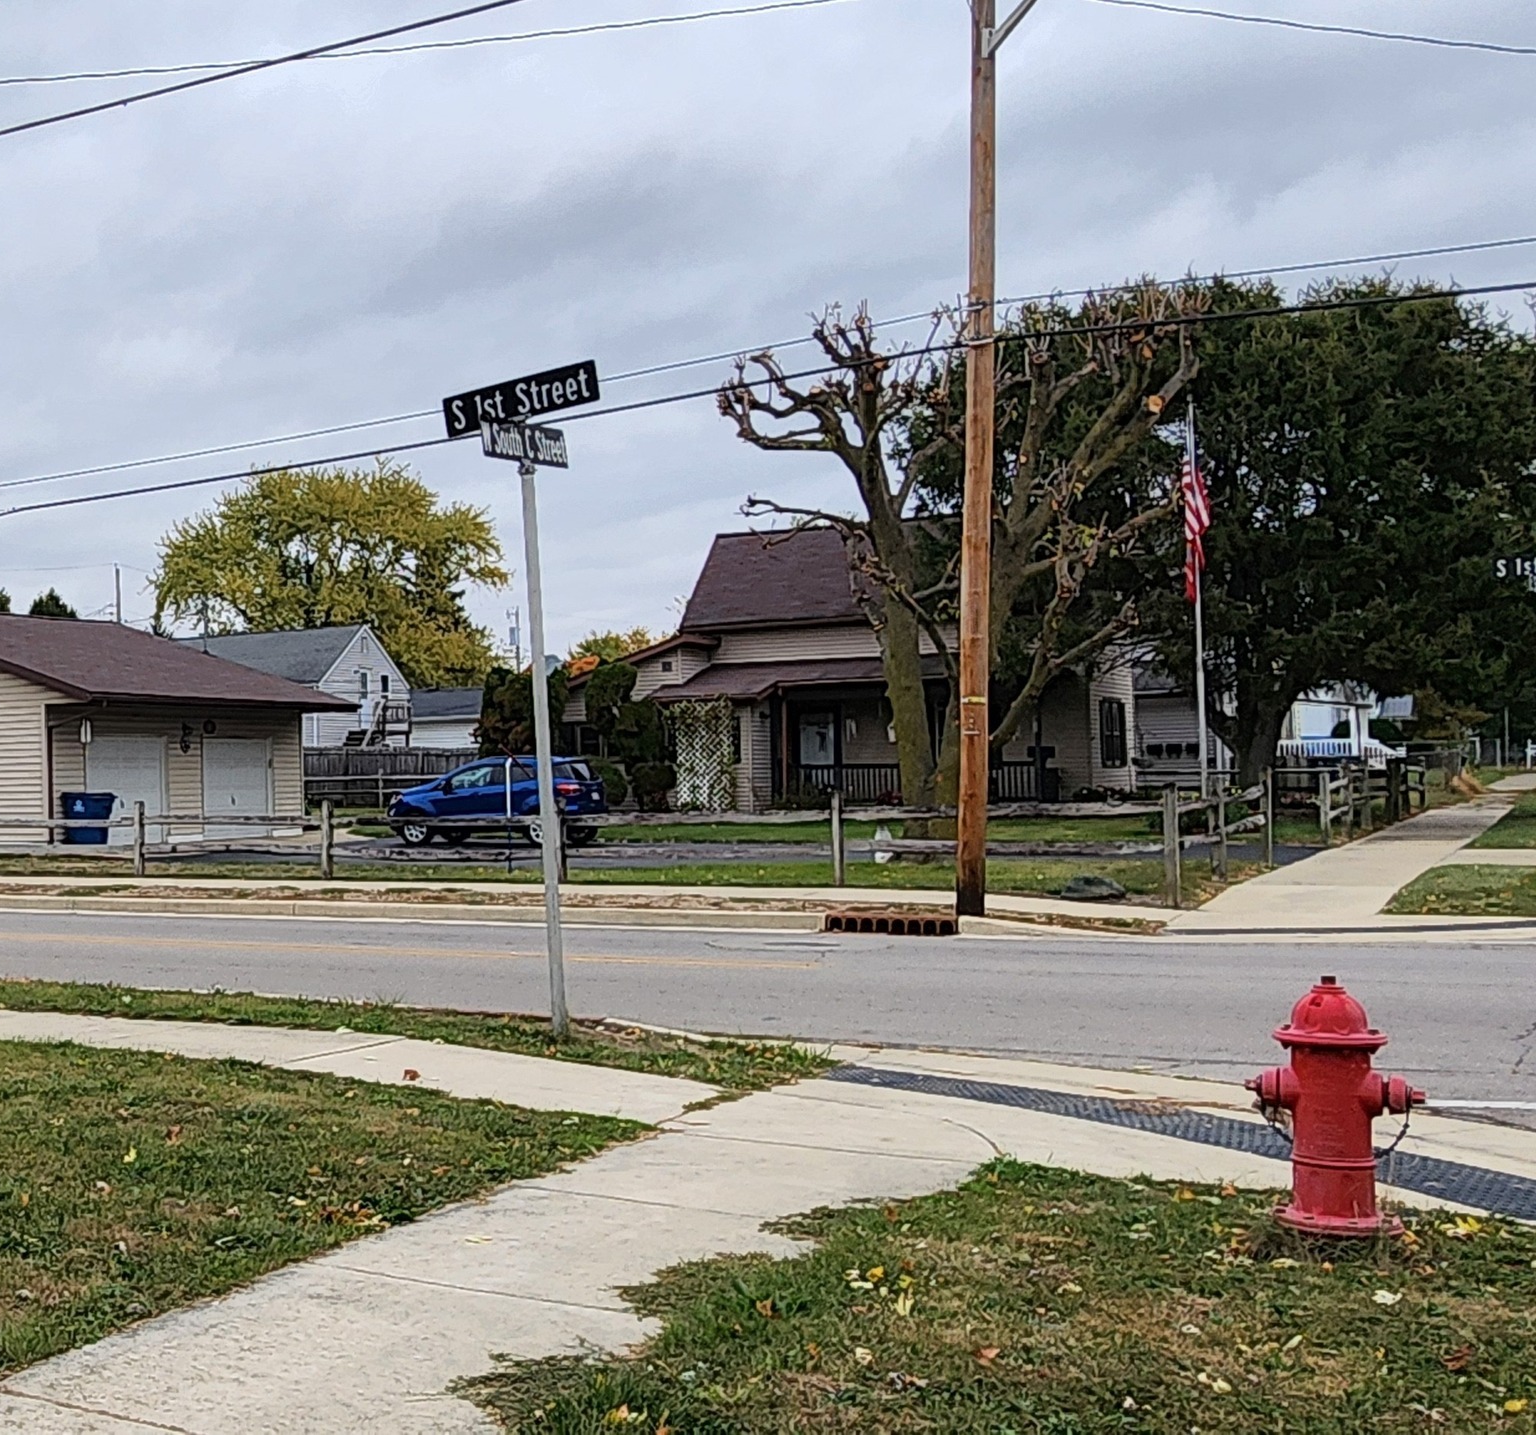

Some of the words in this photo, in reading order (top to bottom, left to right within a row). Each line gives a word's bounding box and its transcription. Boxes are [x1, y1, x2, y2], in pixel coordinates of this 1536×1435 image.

[451, 400, 466, 430] S
[474, 390, 506, 419] 1st
[515, 368, 591, 414] Street
[492, 422, 524, 457] South
[525, 428, 535, 459] C
[535, 429, 568, 464] Street
[1496, 559, 1507, 578] S
